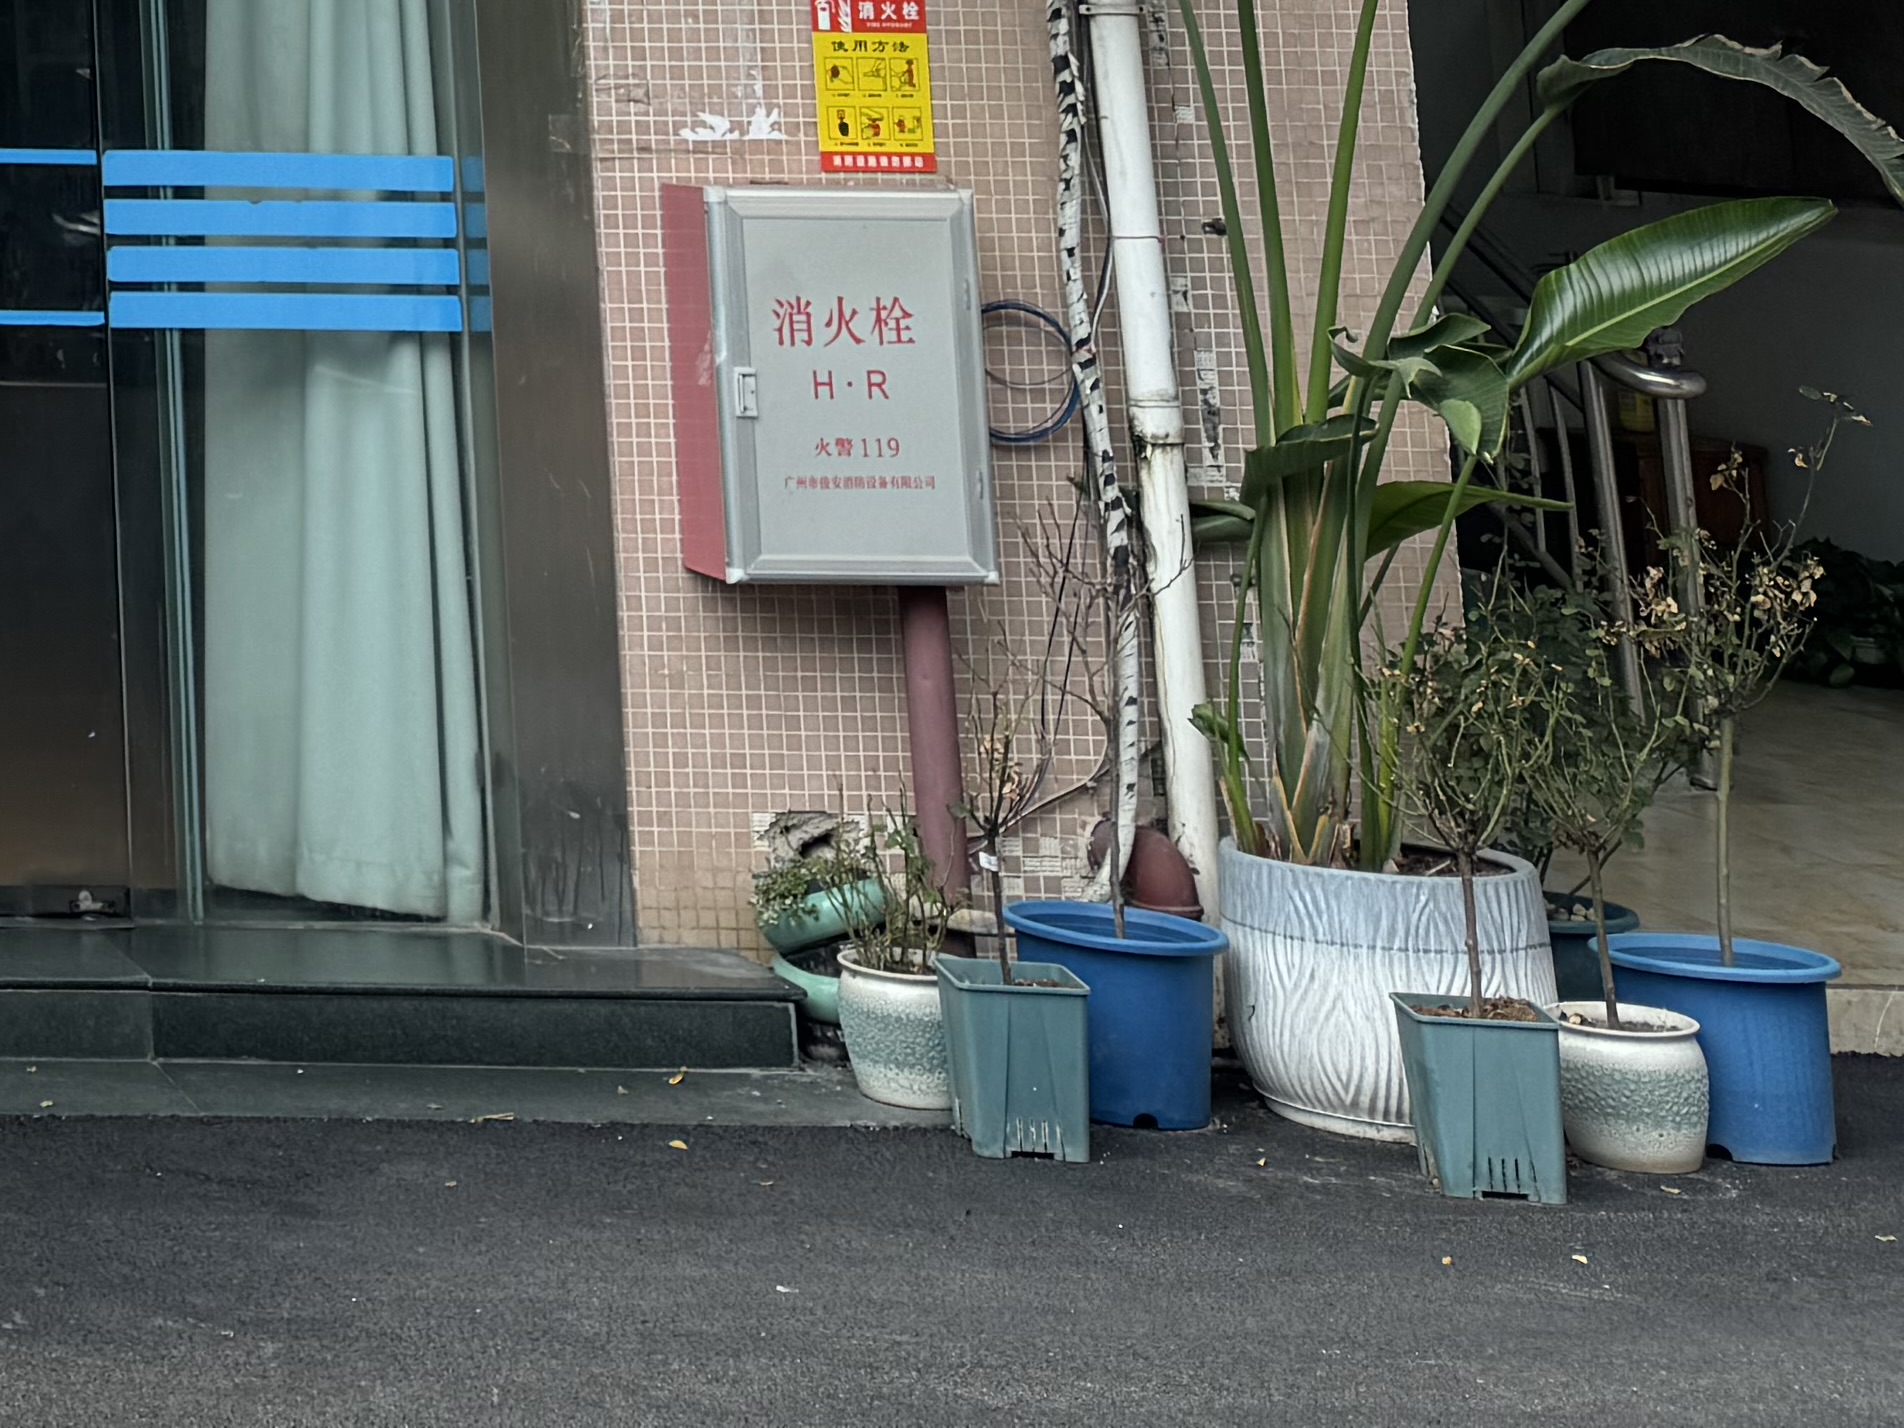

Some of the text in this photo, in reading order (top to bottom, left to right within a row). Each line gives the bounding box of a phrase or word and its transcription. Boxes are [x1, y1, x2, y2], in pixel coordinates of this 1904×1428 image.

[858, 1, 920, 20] 消火栓
[771, 295, 916, 348] 消火栓
